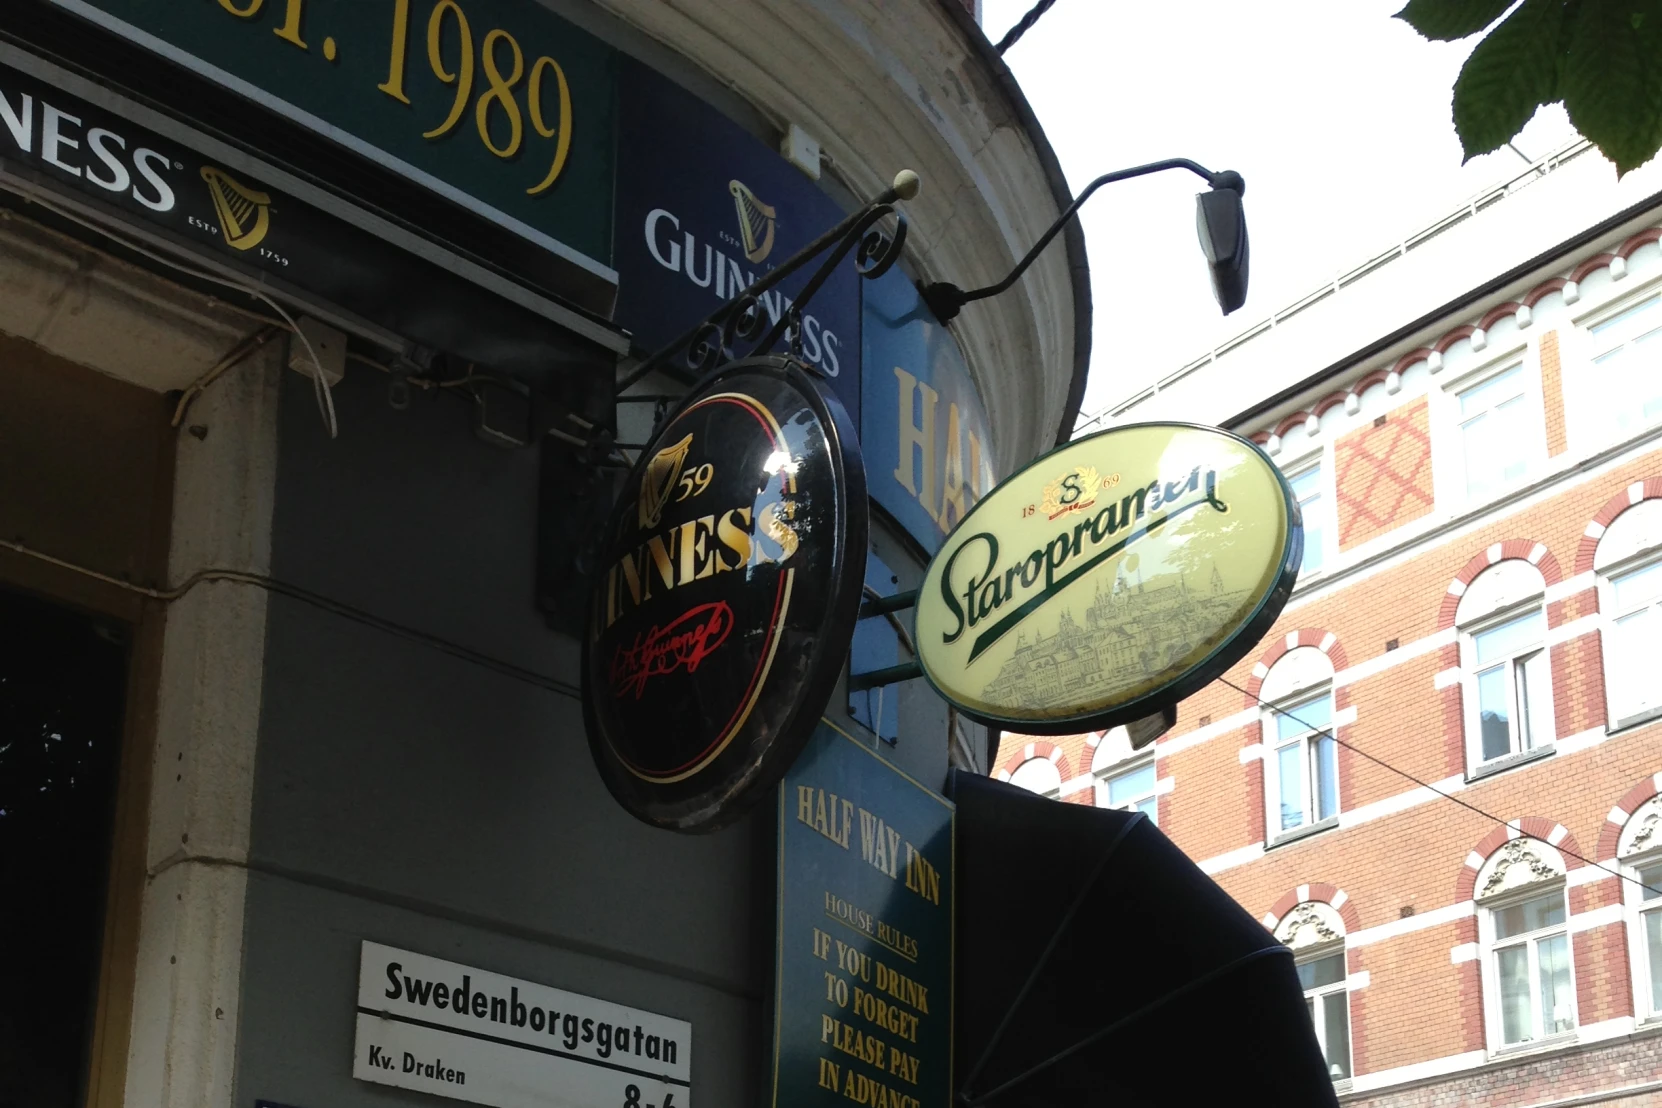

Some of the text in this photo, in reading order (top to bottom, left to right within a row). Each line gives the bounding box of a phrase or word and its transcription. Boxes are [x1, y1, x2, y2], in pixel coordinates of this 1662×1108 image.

[260, 247, 289, 267] 1759
[1021, 504, 1036, 519] 18
[1102, 473, 1120, 489] 69
[797, 785, 940, 905] HALF WAY INN
[825, 891, 918, 958] HOUSE RULES
[813, 927, 929, 1015] IF YOU DRINK
[384, 962, 677, 1065] Swedenborgsgatan
[824, 971, 919, 1043] TO FORGET
[369, 1045, 466, 1085] Kv. Draken
[819, 1057, 839, 1093] IN
[821, 1013, 920, 1086] PLEASE PAY
